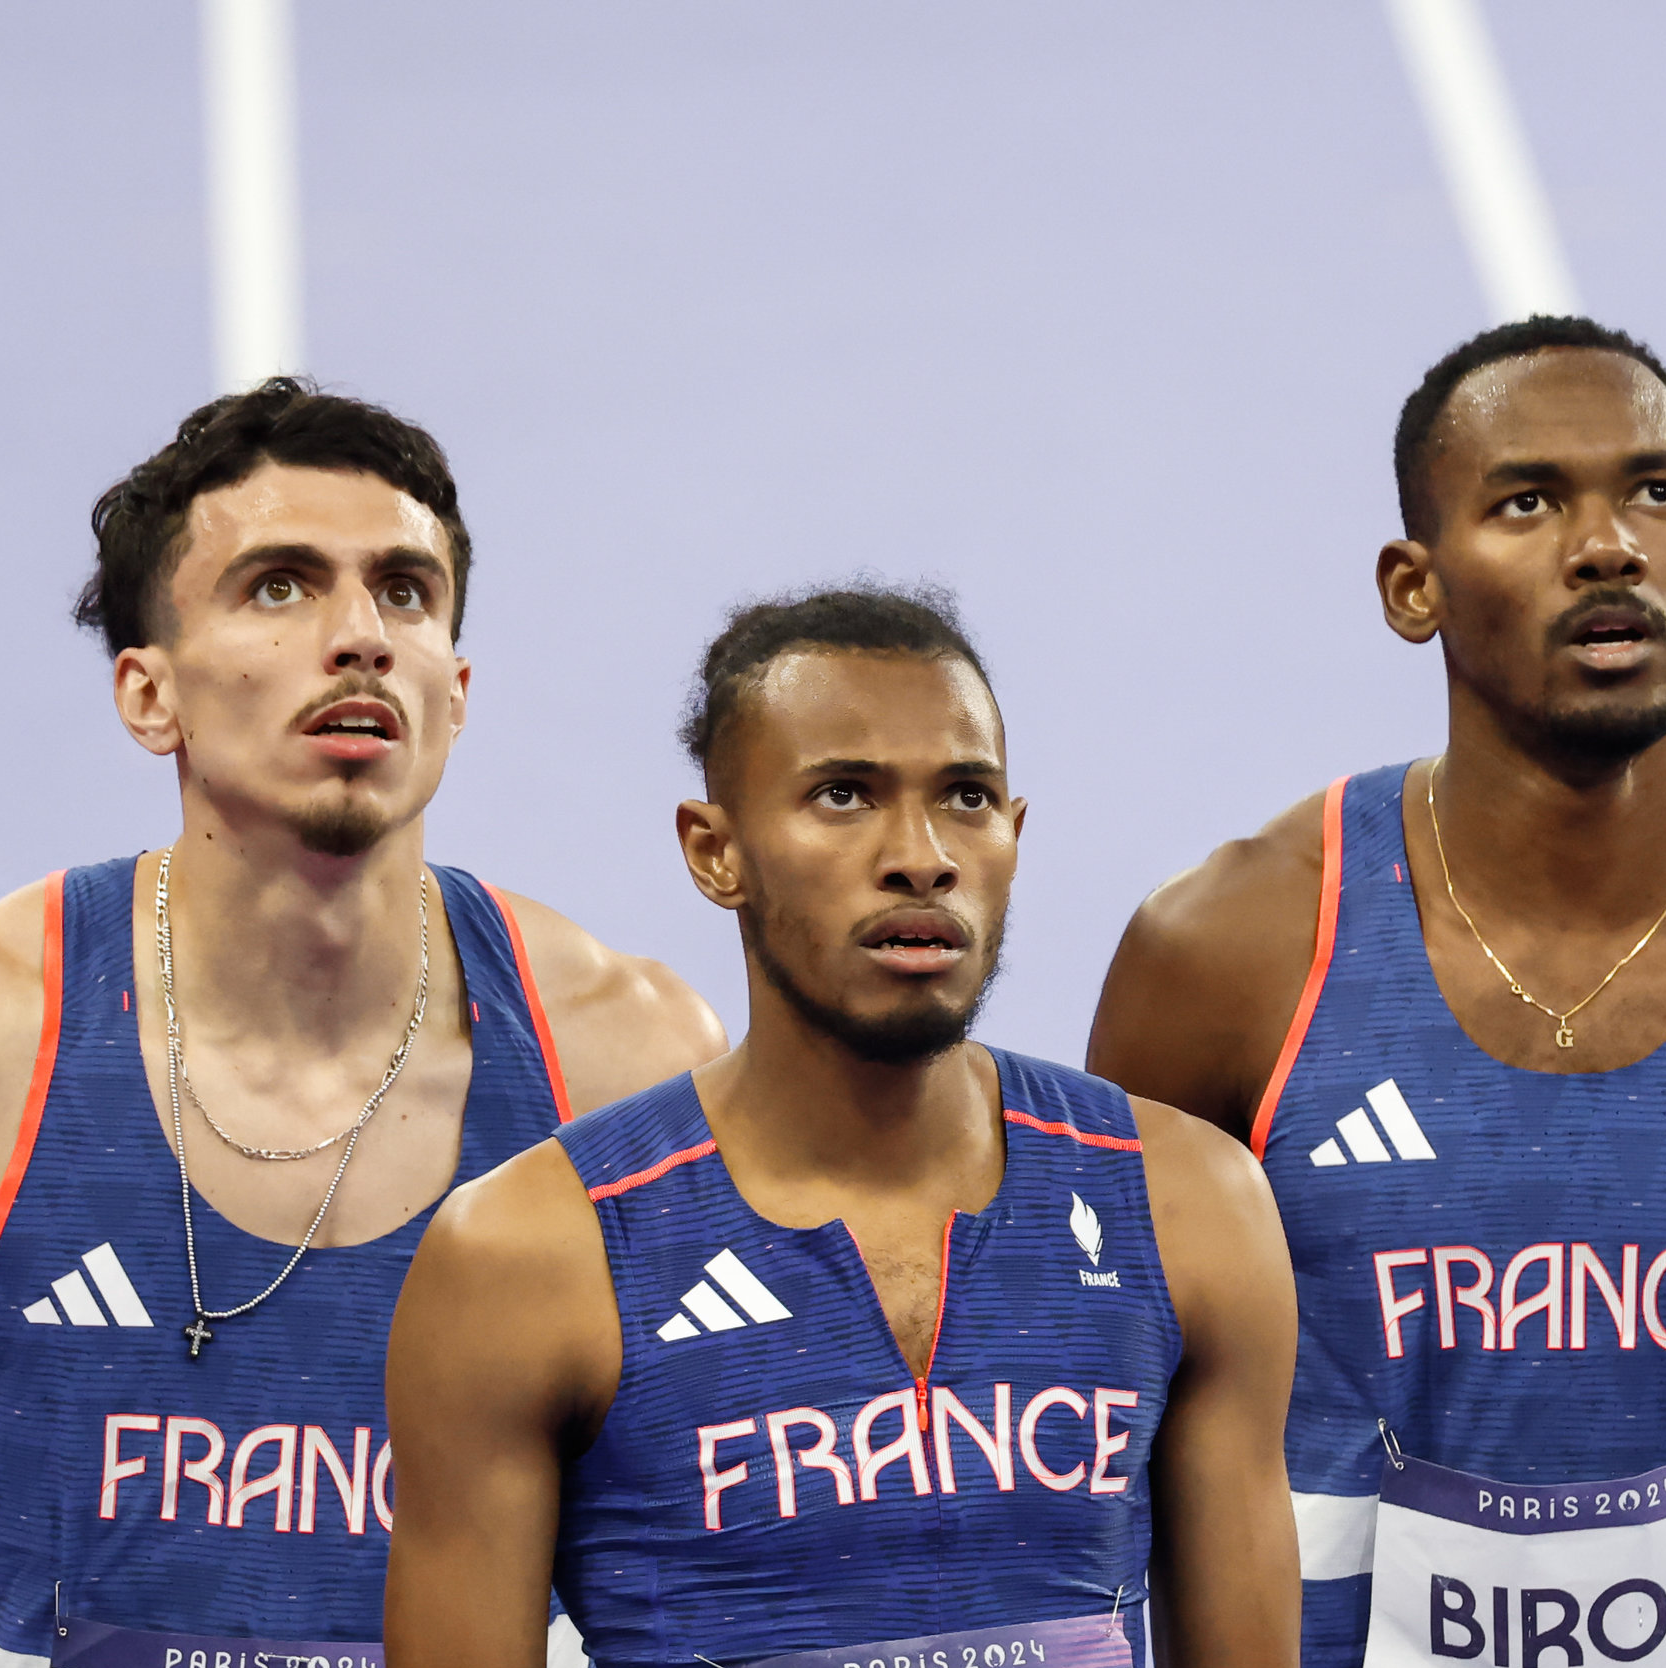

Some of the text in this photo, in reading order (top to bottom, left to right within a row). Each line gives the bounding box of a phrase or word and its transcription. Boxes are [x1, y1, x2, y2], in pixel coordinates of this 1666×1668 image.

[1556, 1029, 1574, 1048] G
[1078, 1269, 1121, 1288] FRANCE
[98, 1413, 395, 1536] FRAN
[696, 1382, 1139, 1530] FRANCE
